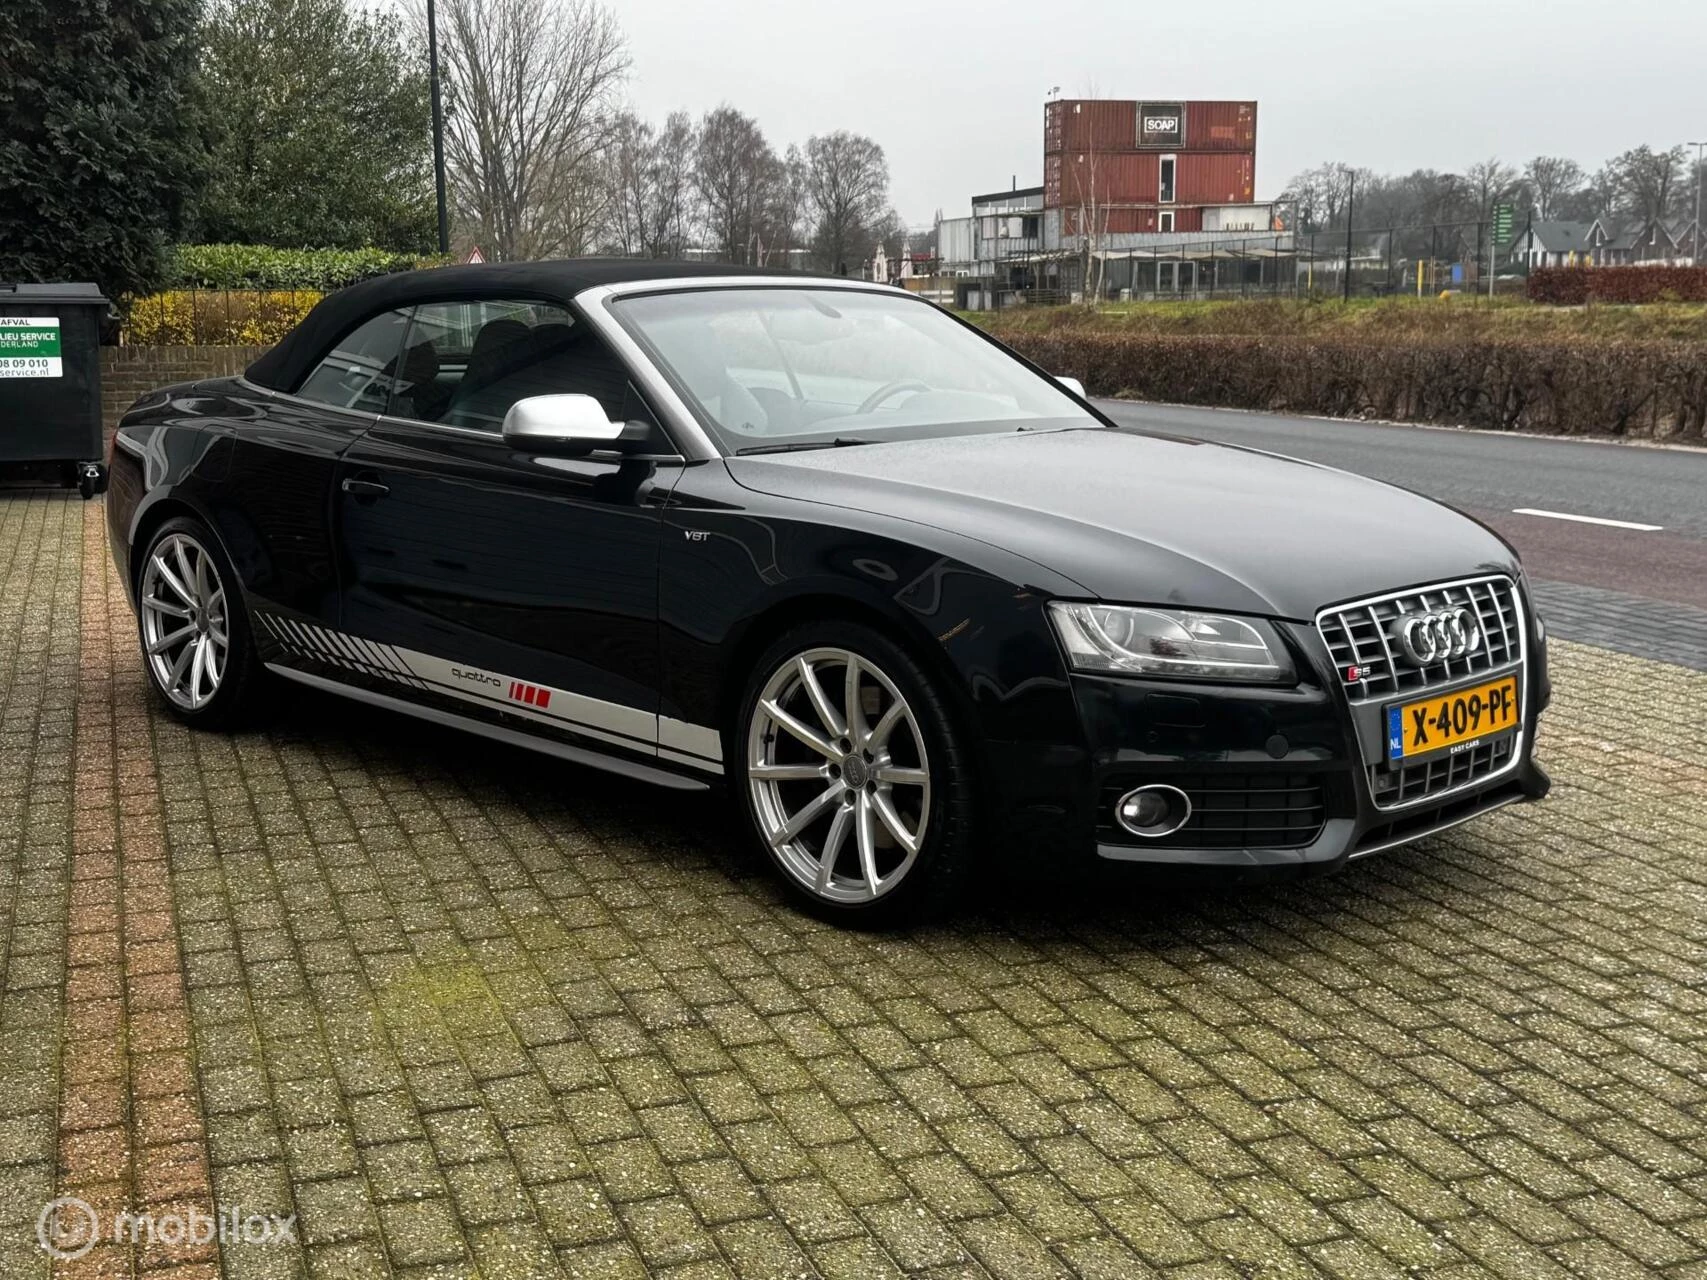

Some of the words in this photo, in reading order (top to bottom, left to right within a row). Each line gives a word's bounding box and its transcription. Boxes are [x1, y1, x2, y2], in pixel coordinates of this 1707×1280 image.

[1147, 120, 1175, 131] SOAP
[20, 333, 56, 341] SERVICE
[12, 359, 26, 367] 09
[28, 359, 48, 367] 010
[451, 667, 501, 687] quattro
[1412, 684, 1512, 747] X-409-PF
[1389, 737, 1401, 751] NL
[1450, 744, 1465, 754] EASY
[1465, 739, 1480, 749] CARS
